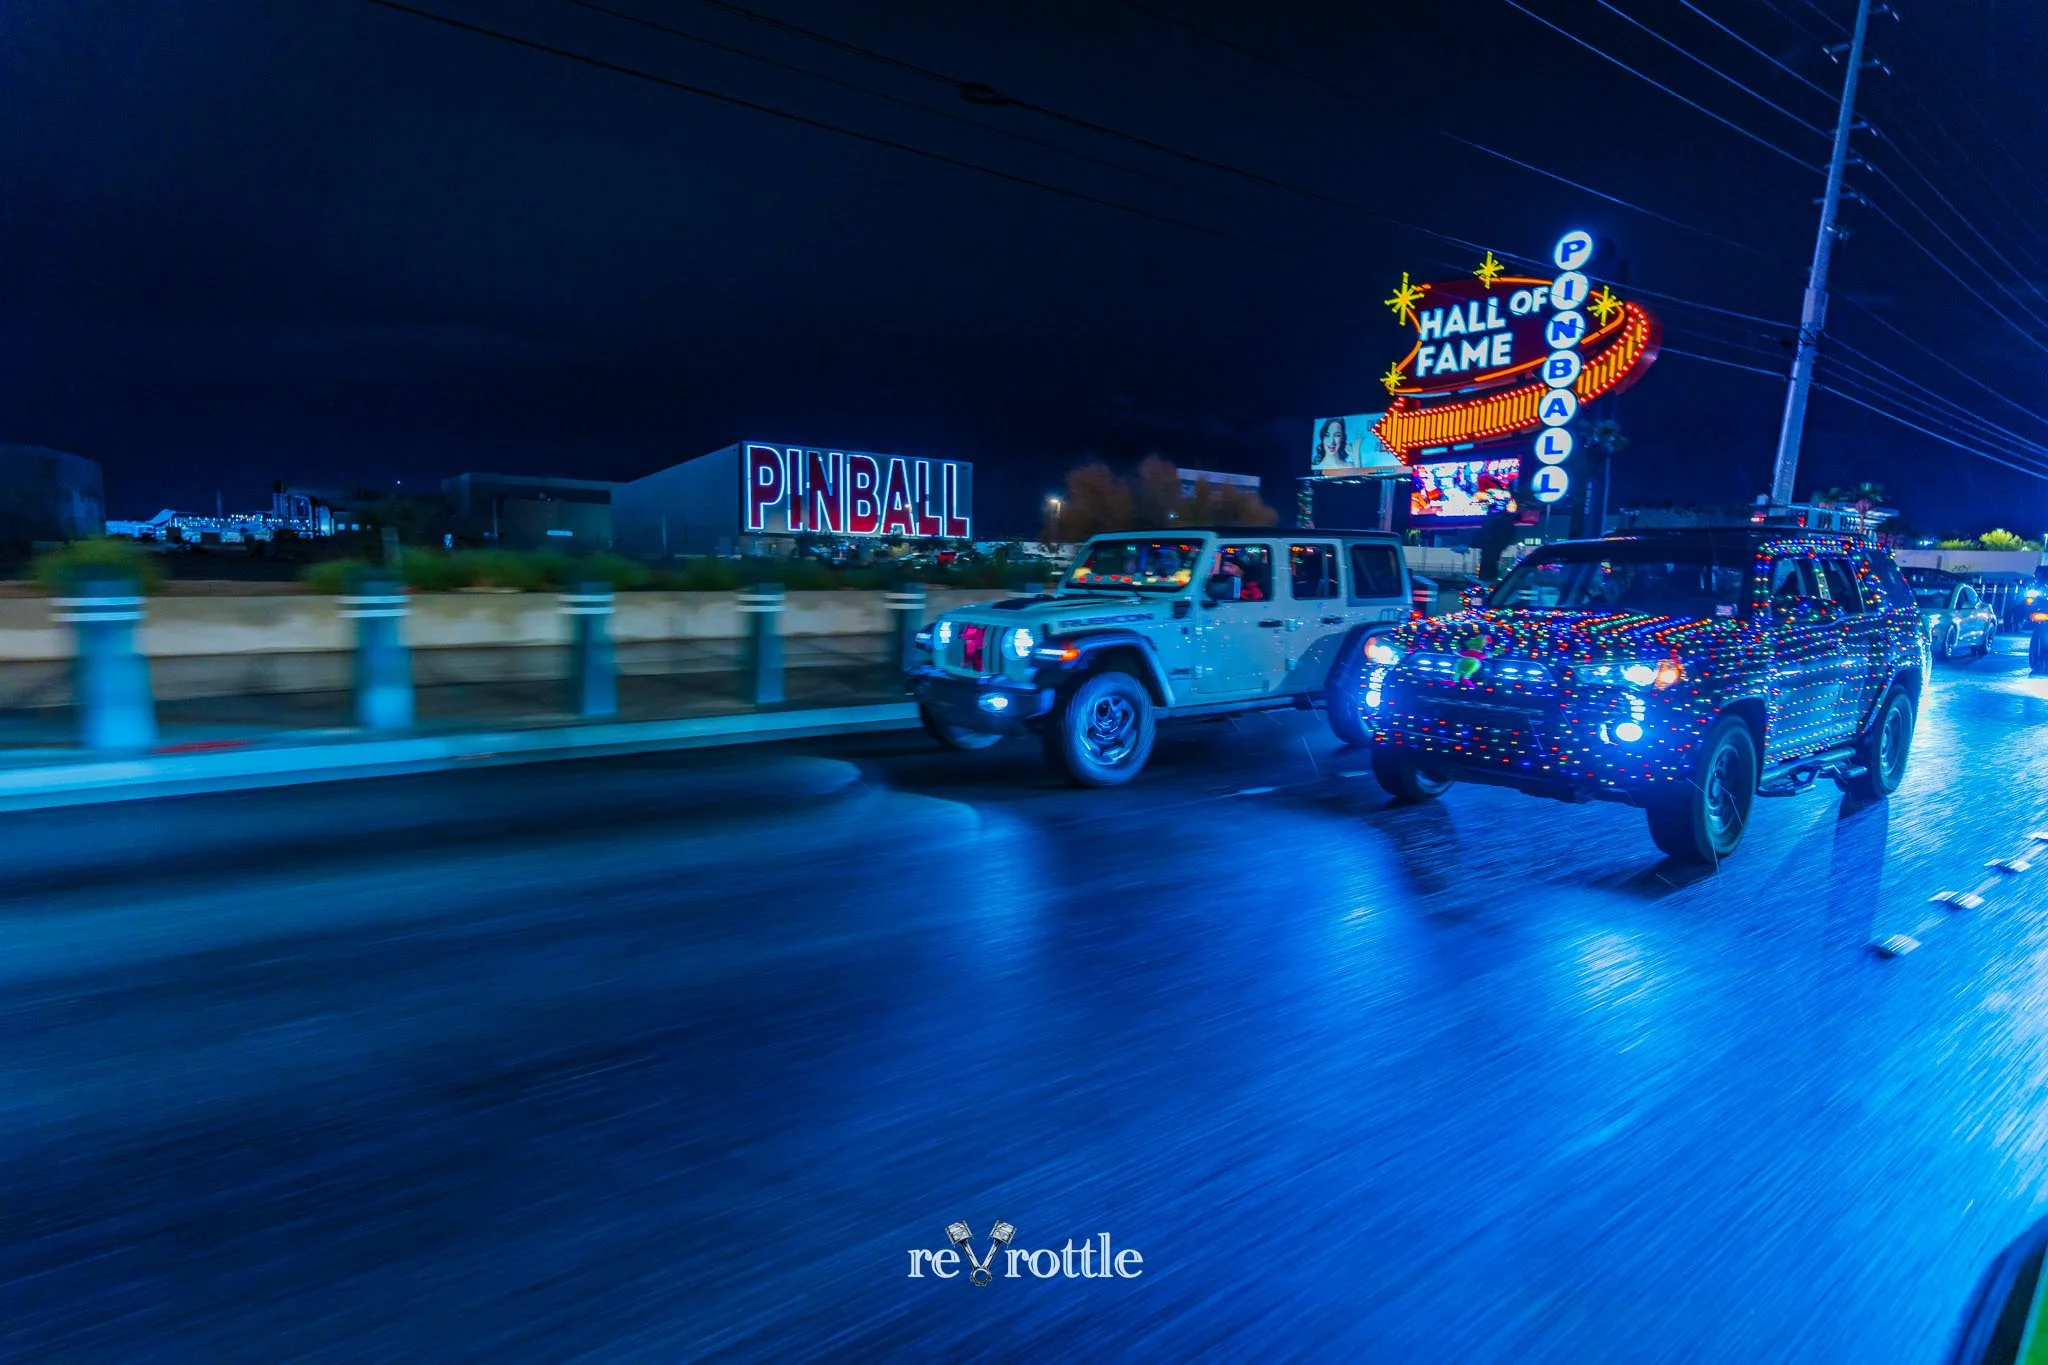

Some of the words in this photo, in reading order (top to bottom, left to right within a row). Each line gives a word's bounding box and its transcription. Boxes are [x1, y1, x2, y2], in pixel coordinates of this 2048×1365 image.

[1420, 297, 1506, 341] HALL
[1509, 286, 1550, 316] OF
[1416, 332, 1513, 377] FAME
[1541, 239, 1587, 494] PINBALL
[747, 444, 970, 539] PINBALL
